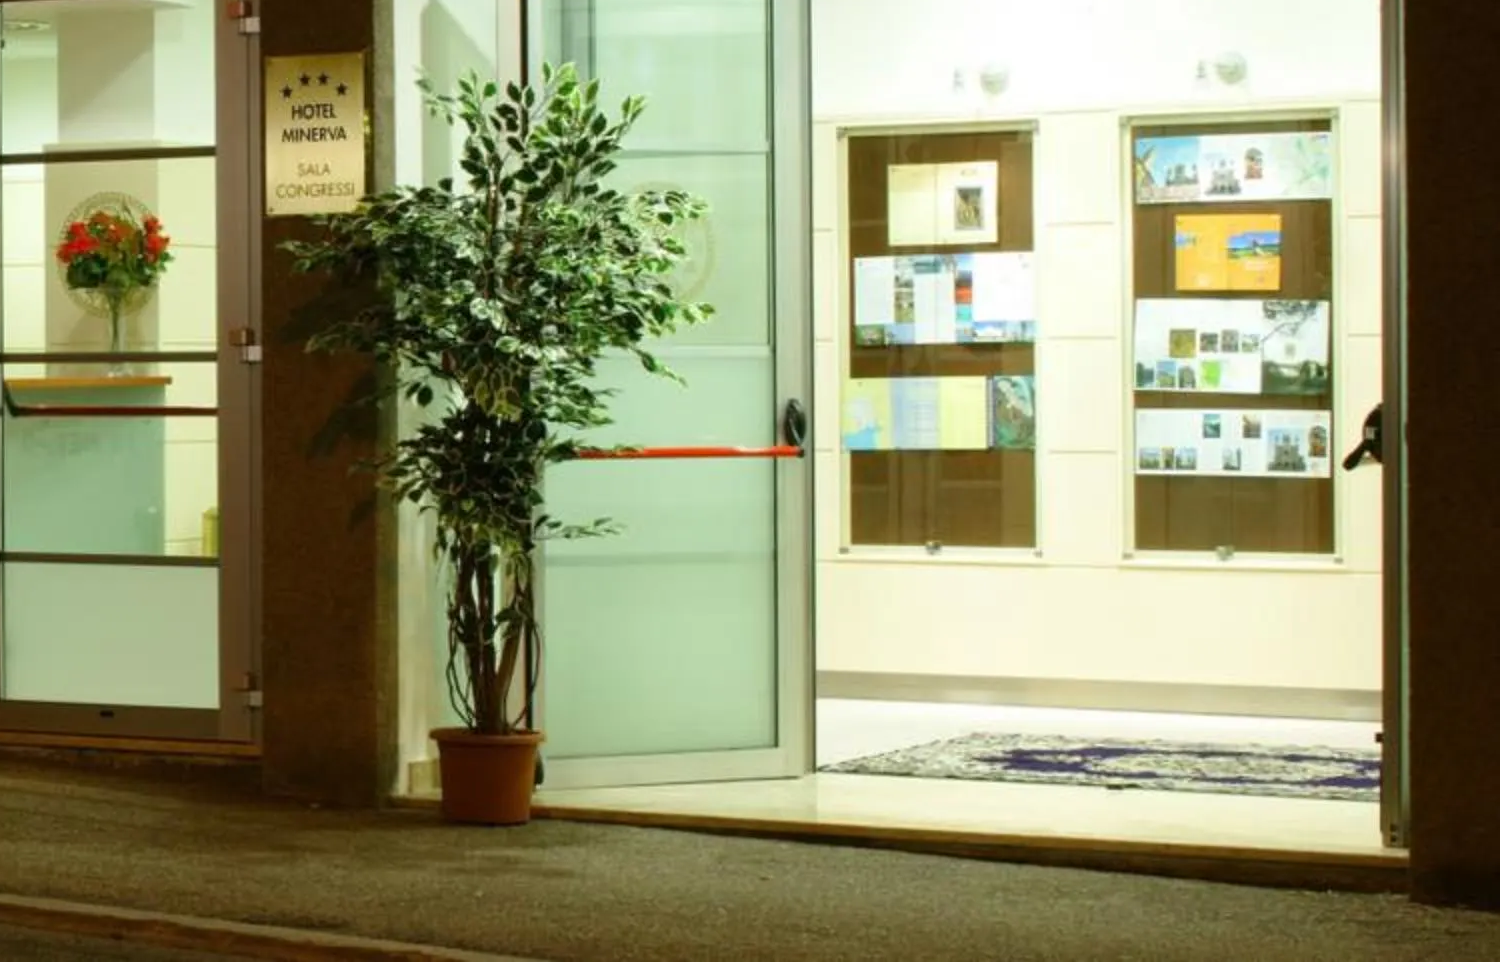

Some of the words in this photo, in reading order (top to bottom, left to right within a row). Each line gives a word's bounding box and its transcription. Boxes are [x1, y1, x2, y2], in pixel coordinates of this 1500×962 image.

[292, 104, 337, 120] HOTEL
[282, 127, 347, 142] MINERVA
[298, 162, 331, 176] SALA
[276, 183, 354, 198] CONGRESSI
